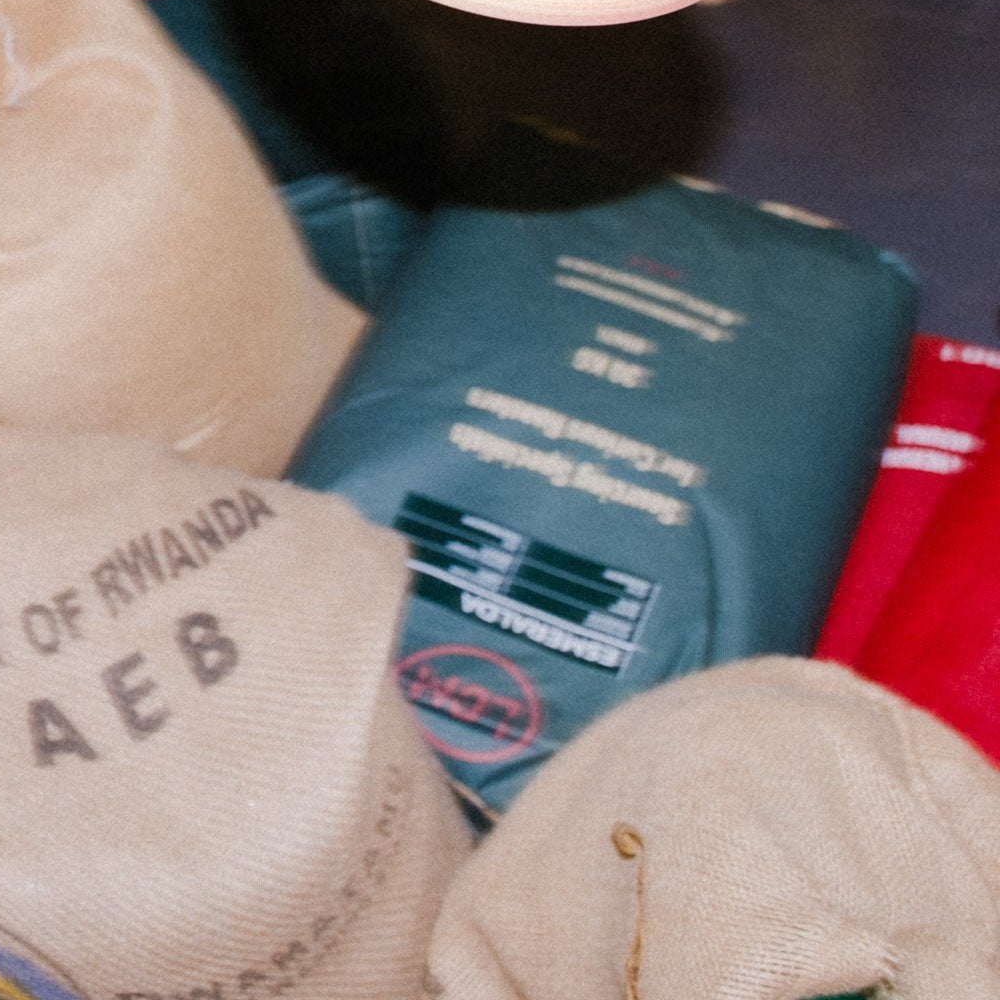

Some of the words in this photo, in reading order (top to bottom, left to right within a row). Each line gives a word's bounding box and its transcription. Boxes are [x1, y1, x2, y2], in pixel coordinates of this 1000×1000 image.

[20, 587, 83, 655] OF
[90, 486, 277, 618] RWANDA
[460, 590, 622, 668] ESMERALDA
